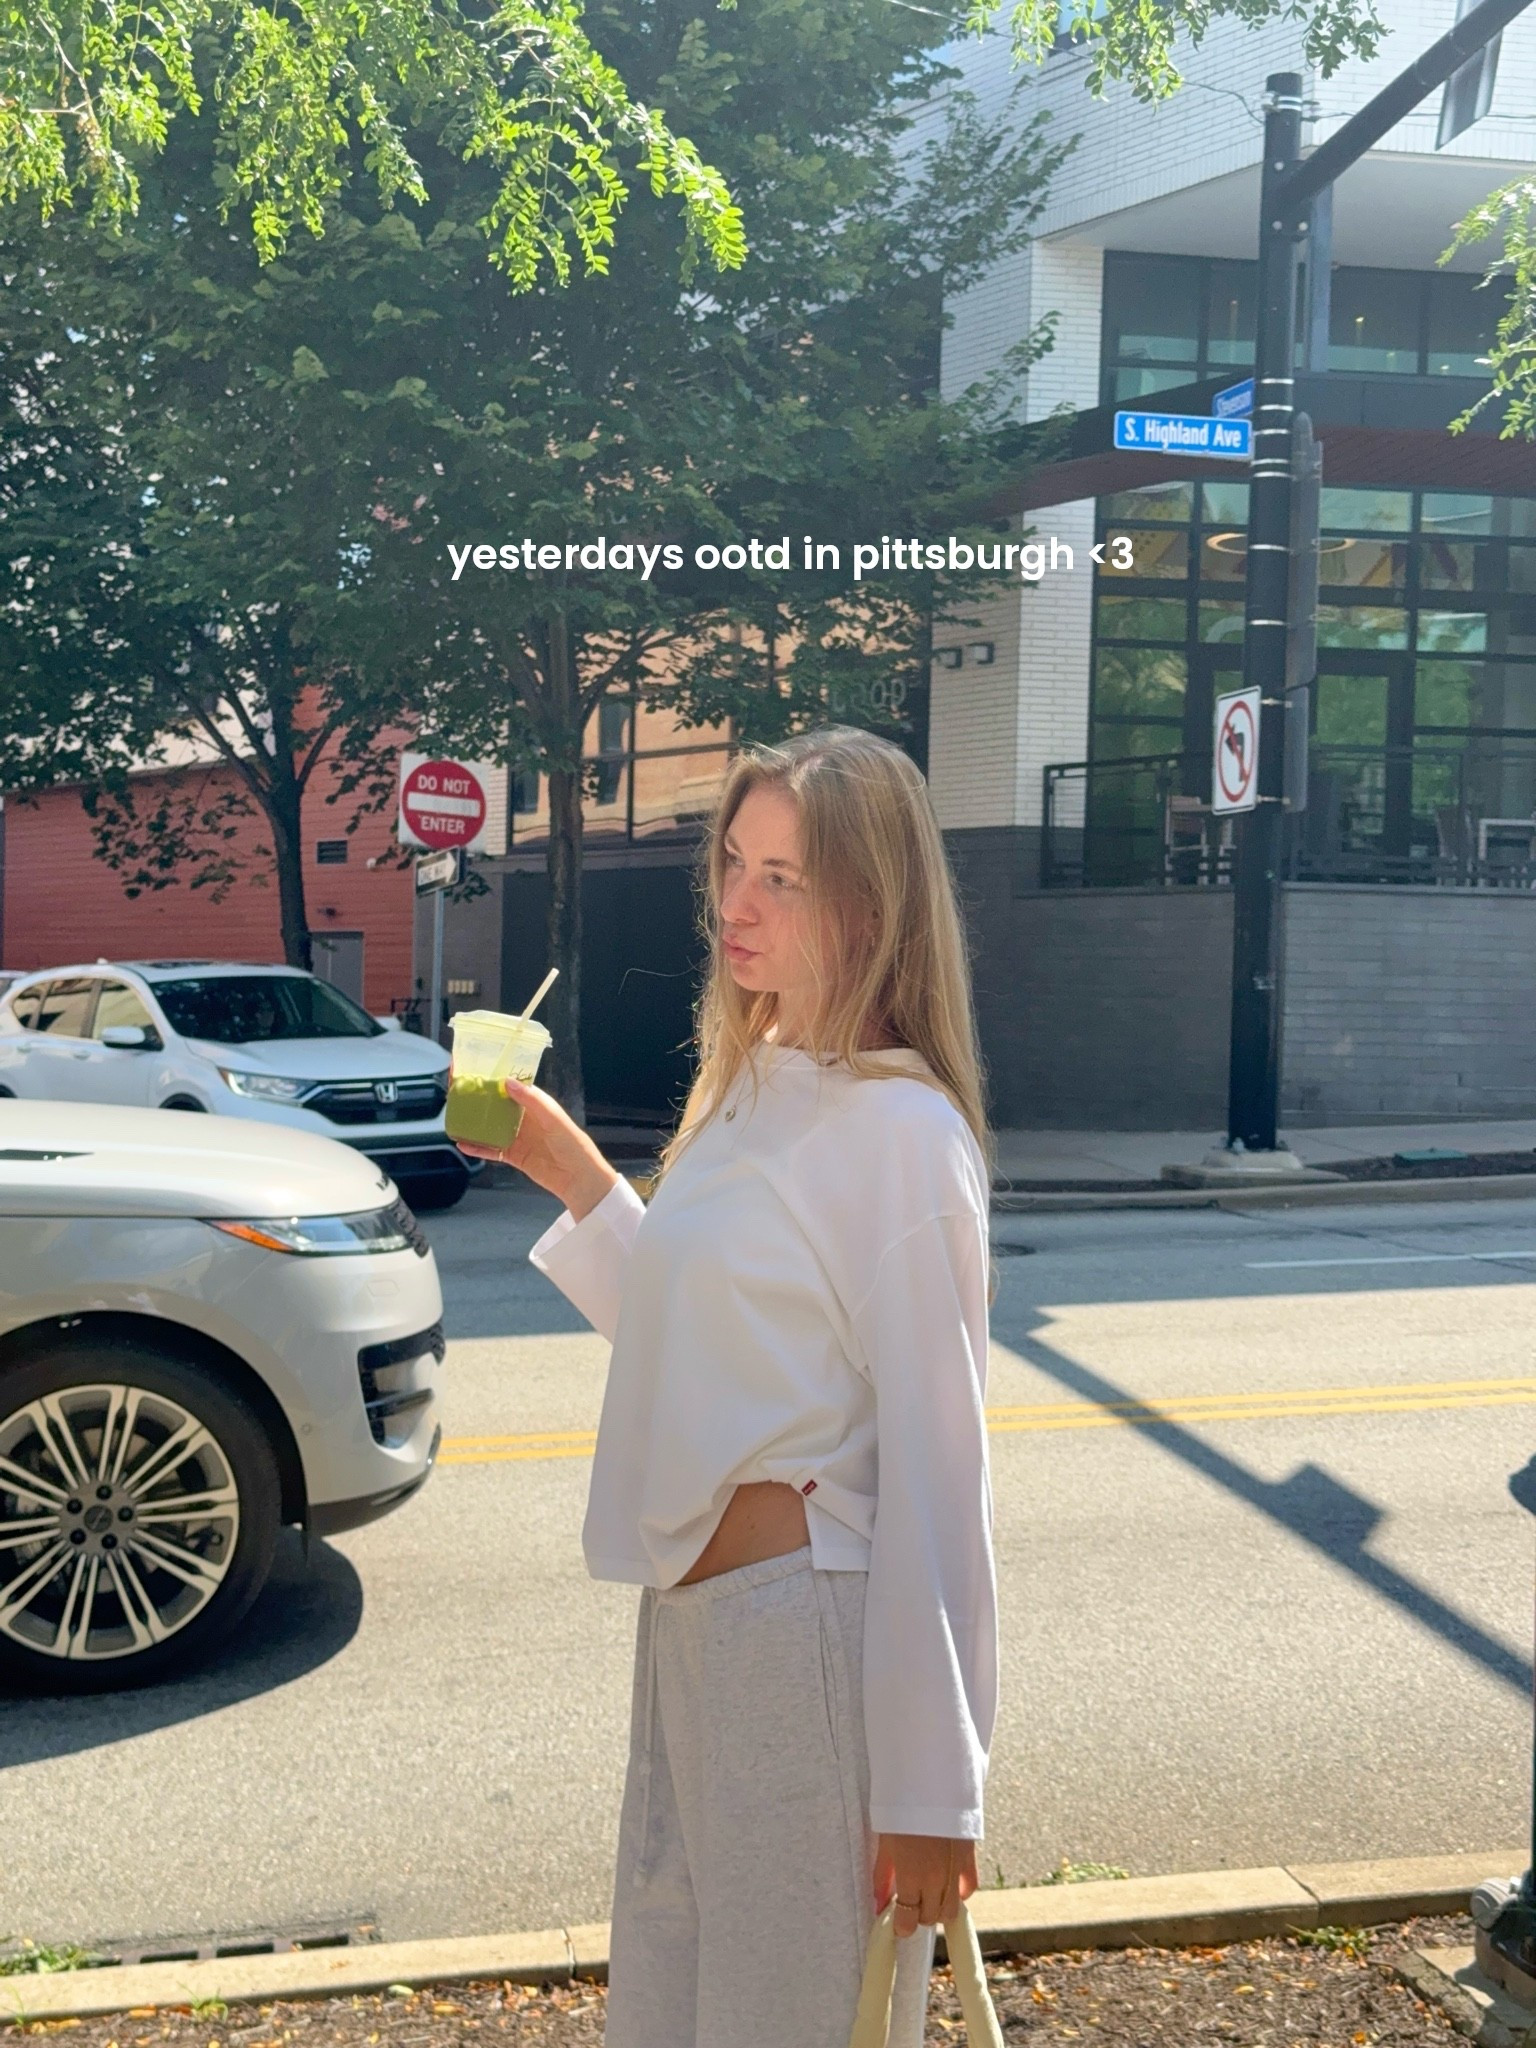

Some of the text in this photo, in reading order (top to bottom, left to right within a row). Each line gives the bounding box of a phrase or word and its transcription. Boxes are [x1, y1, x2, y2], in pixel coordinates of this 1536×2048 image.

[1125, 418, 1241, 449] S. Highland Ave
[418, 776, 470, 794] DO NOT
[421, 817, 465, 834] ENTER
